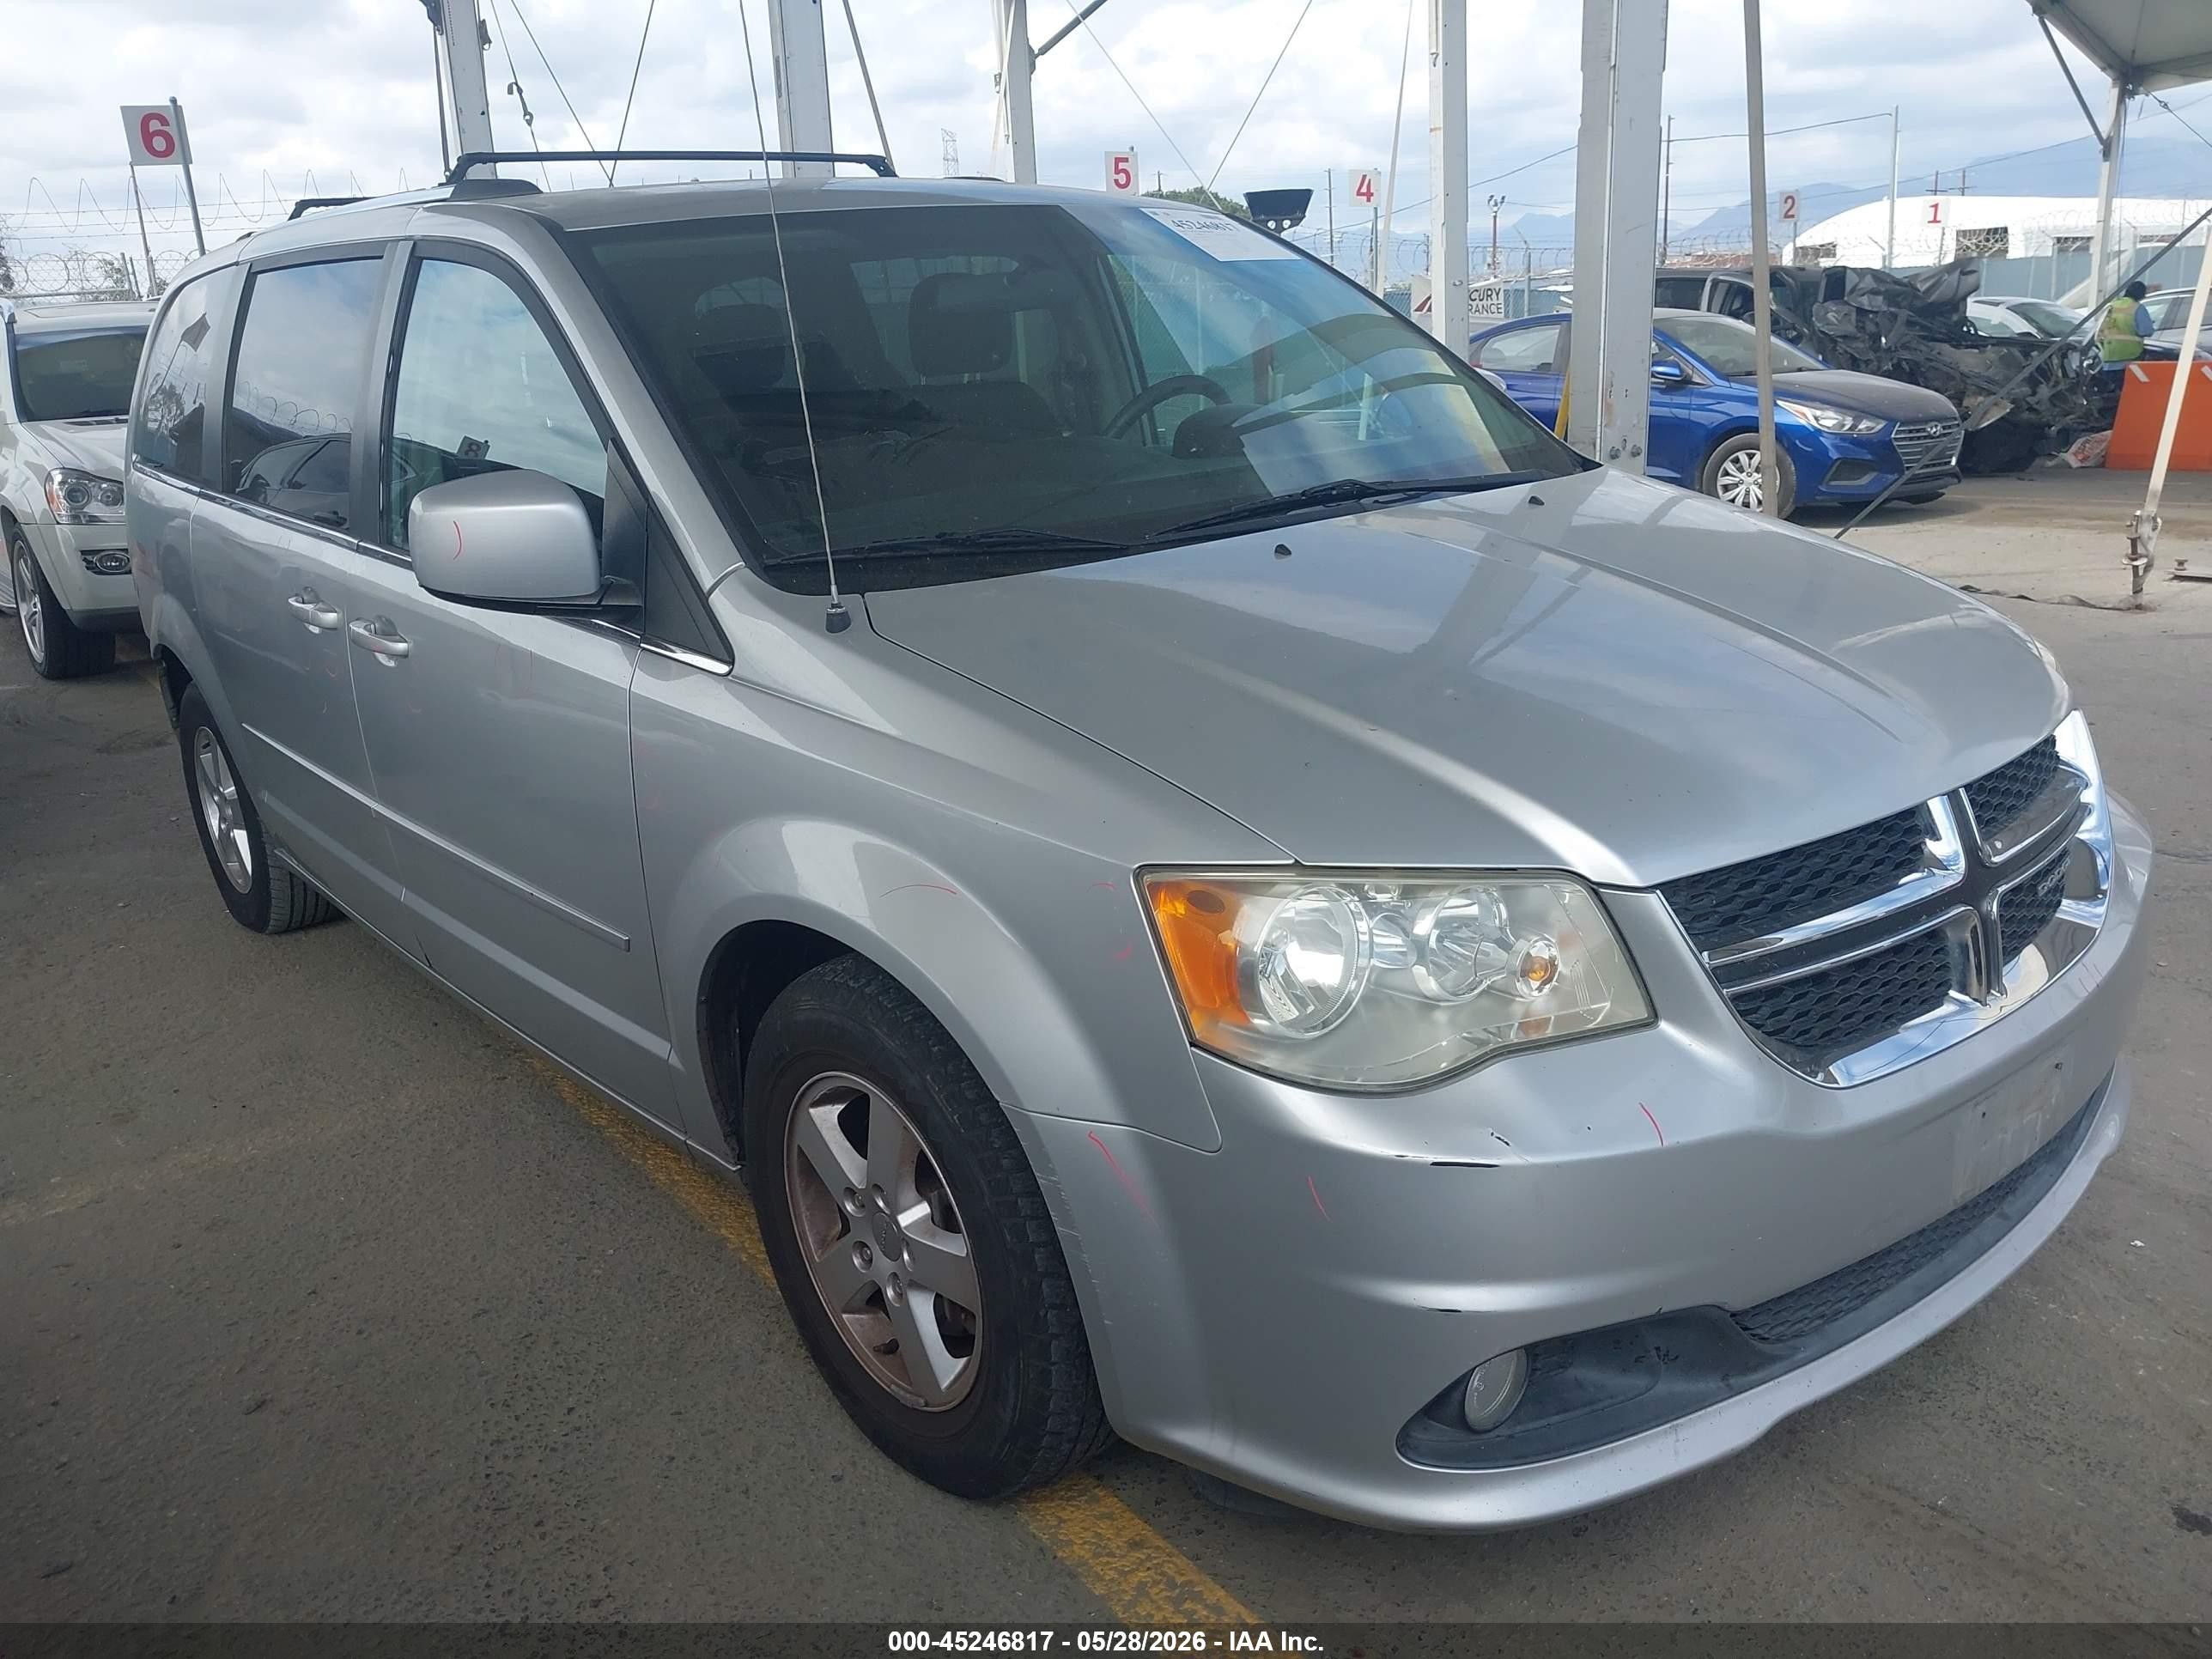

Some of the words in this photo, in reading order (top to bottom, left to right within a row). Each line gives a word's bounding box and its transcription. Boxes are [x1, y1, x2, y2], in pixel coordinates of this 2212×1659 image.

[140, 112, 175, 159] 6
[1113, 156, 1132, 190] 5
[1356, 174, 1374, 203] 4
[1784, 195, 1796, 219] 2
[1927, 203, 1942, 224] 1
[1468, 288, 1501, 302] CURY
[1468, 302, 1503, 315] RANCE
